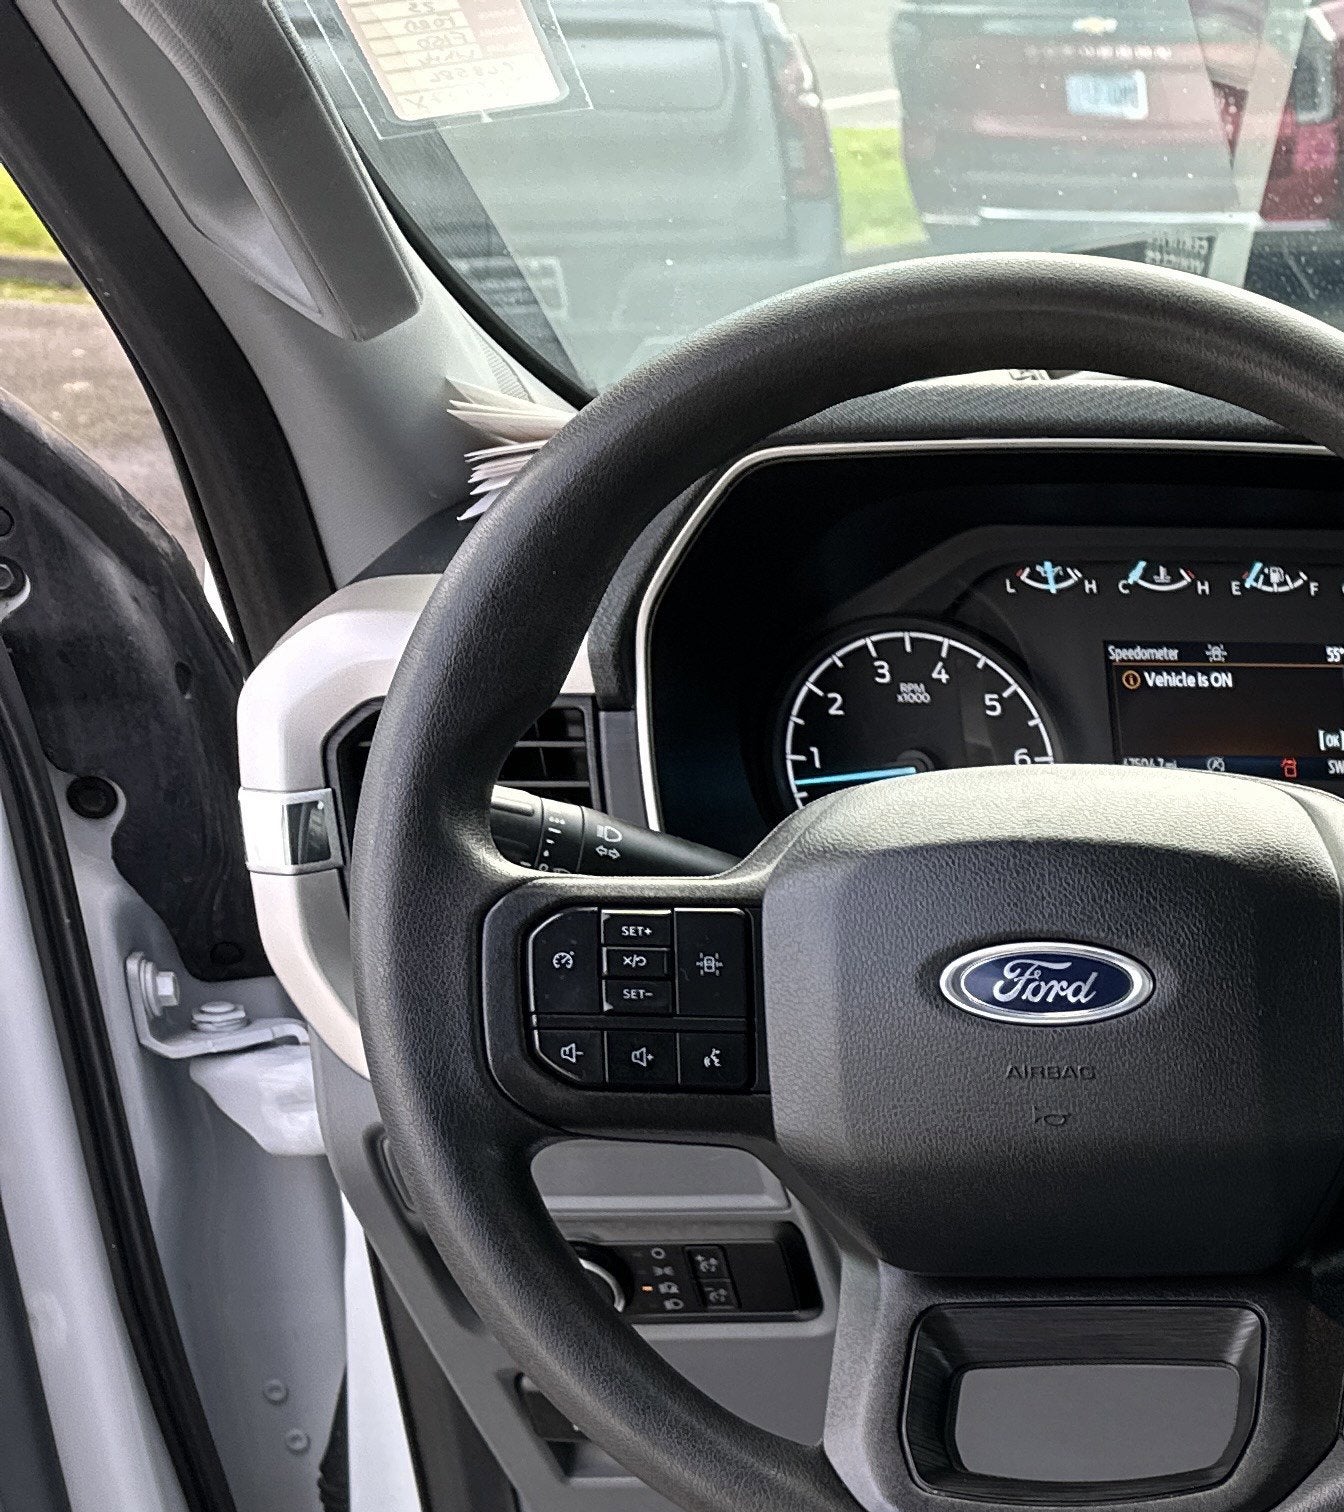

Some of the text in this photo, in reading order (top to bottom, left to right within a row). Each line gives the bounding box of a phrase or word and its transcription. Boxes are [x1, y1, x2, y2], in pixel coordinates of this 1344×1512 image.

[1006, 580, 1016, 594] L
[1085, 580, 1097, 594] H
[1118, 580, 1130, 594] C
[1198, 581, 1210, 595] H
[1231, 581, 1242, 595] E
[1310, 581, 1319, 596] F
[1107, 645, 1179, 662] Speedometer
[873, 660, 891, 684] 3
[931, 661, 950, 684] 4
[1143, 671, 1196, 688] Vehicle
[1210, 671, 1233, 688] ON
[899, 682, 926, 693] RPM
[827, 692, 845, 715] 2
[984, 693, 1002, 717] 5
[809, 746, 821, 769] 1
[1013, 748, 1031, 765] 6
[992, 959, 1098, 1004] Ford
[1006, 1064, 1098, 1081] AIRBAG
